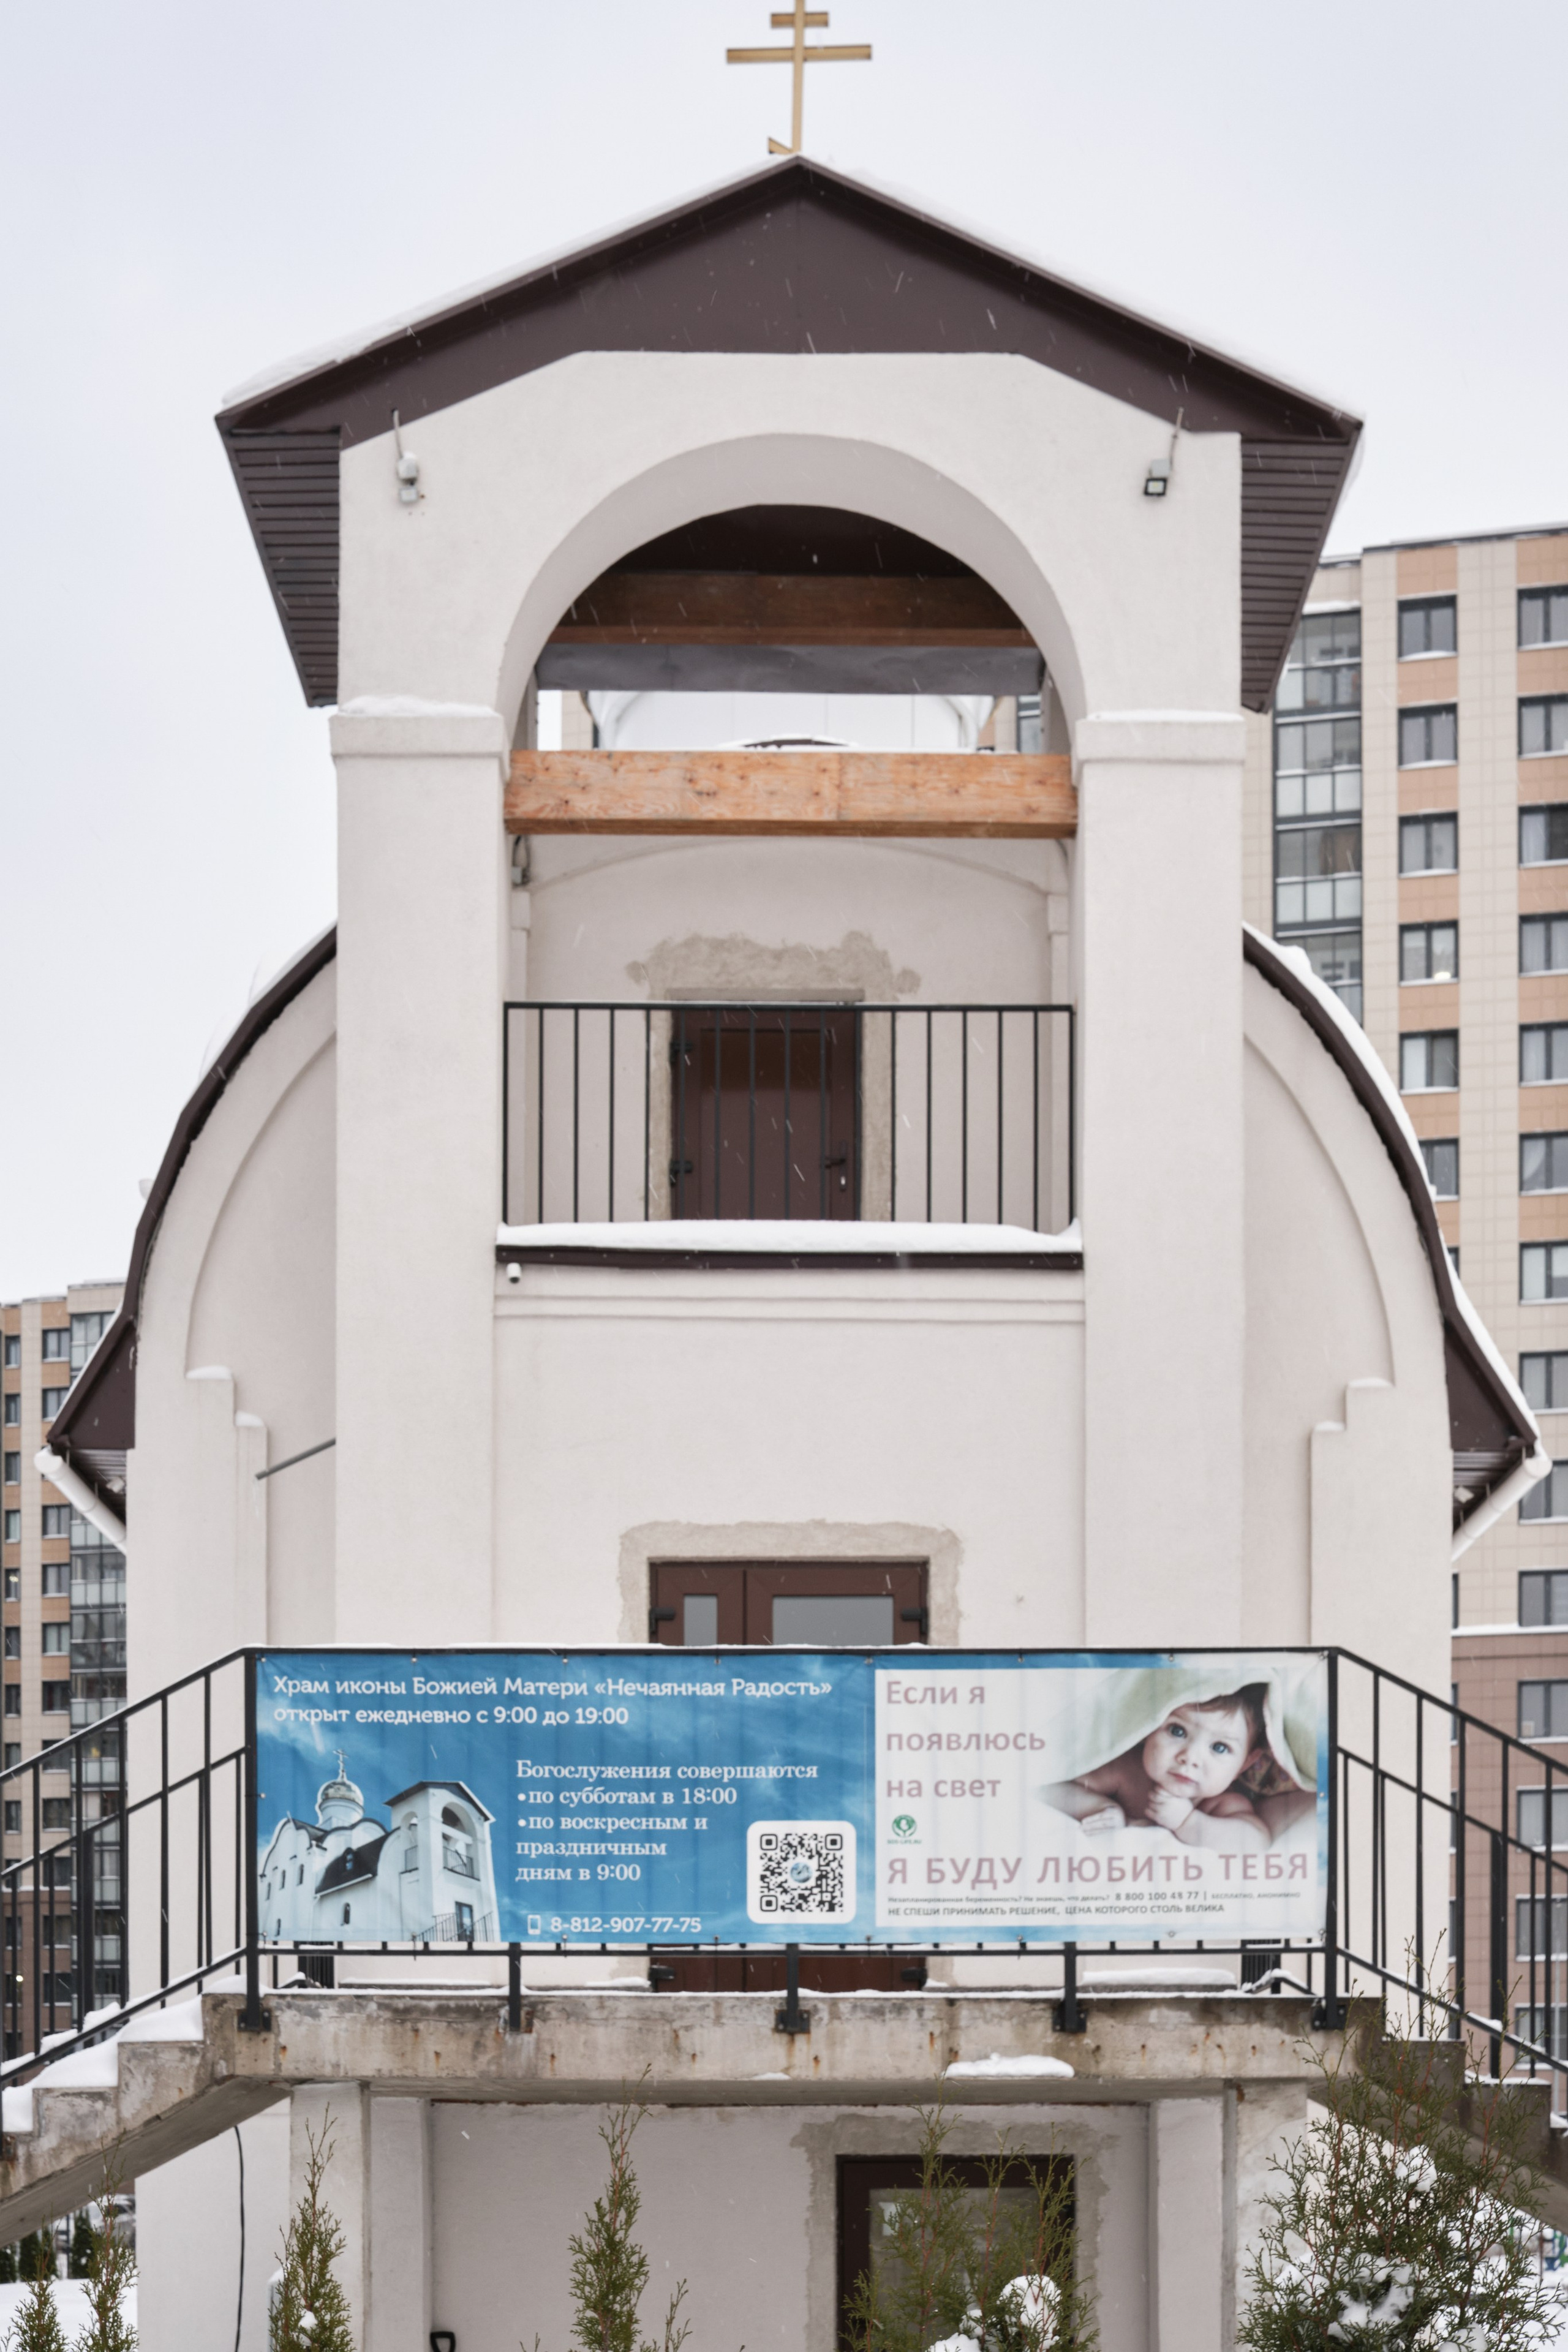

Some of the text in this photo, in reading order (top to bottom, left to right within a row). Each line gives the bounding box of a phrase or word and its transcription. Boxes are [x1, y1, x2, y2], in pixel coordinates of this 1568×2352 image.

[274, 1676, 832, 1699] Храм иконы Божией Матери «Нечаянная Радость»
[887, 1681, 985, 1705] Если я
[274, 1707, 628, 1727] открыт ежедневно с 9:00 до 19:00
[887, 1732, 1045, 1751] появлюсь
[517, 1760, 818, 1782] Богослужения совершаются
[560, 1788, 655, 1808] субботам
[662, 1791, 674, 1803] в
[682, 1788, 736, 1804] 18:00
[887, 1779, 1000, 1798] на свет
[560, 1817, 687, 1834] воскресным
[695, 1816, 707, 1829] и
[516, 1842, 667, 1859] праздничным
[515, 1864, 641, 1882] дням в 9:00
[888, 1854, 1307, 1890] Я БУДУ ЛЮБИТЬ ТЕБЯ
[1010, 1907, 1060, 1915] РЕШЕНИЕ,
[1066, 1906, 1091, 1915] ЦЕНА
[1095, 1905, 1147, 1914] КОТОРОГО
[551, 1917, 701, 1933] 8-812-907-77-75
